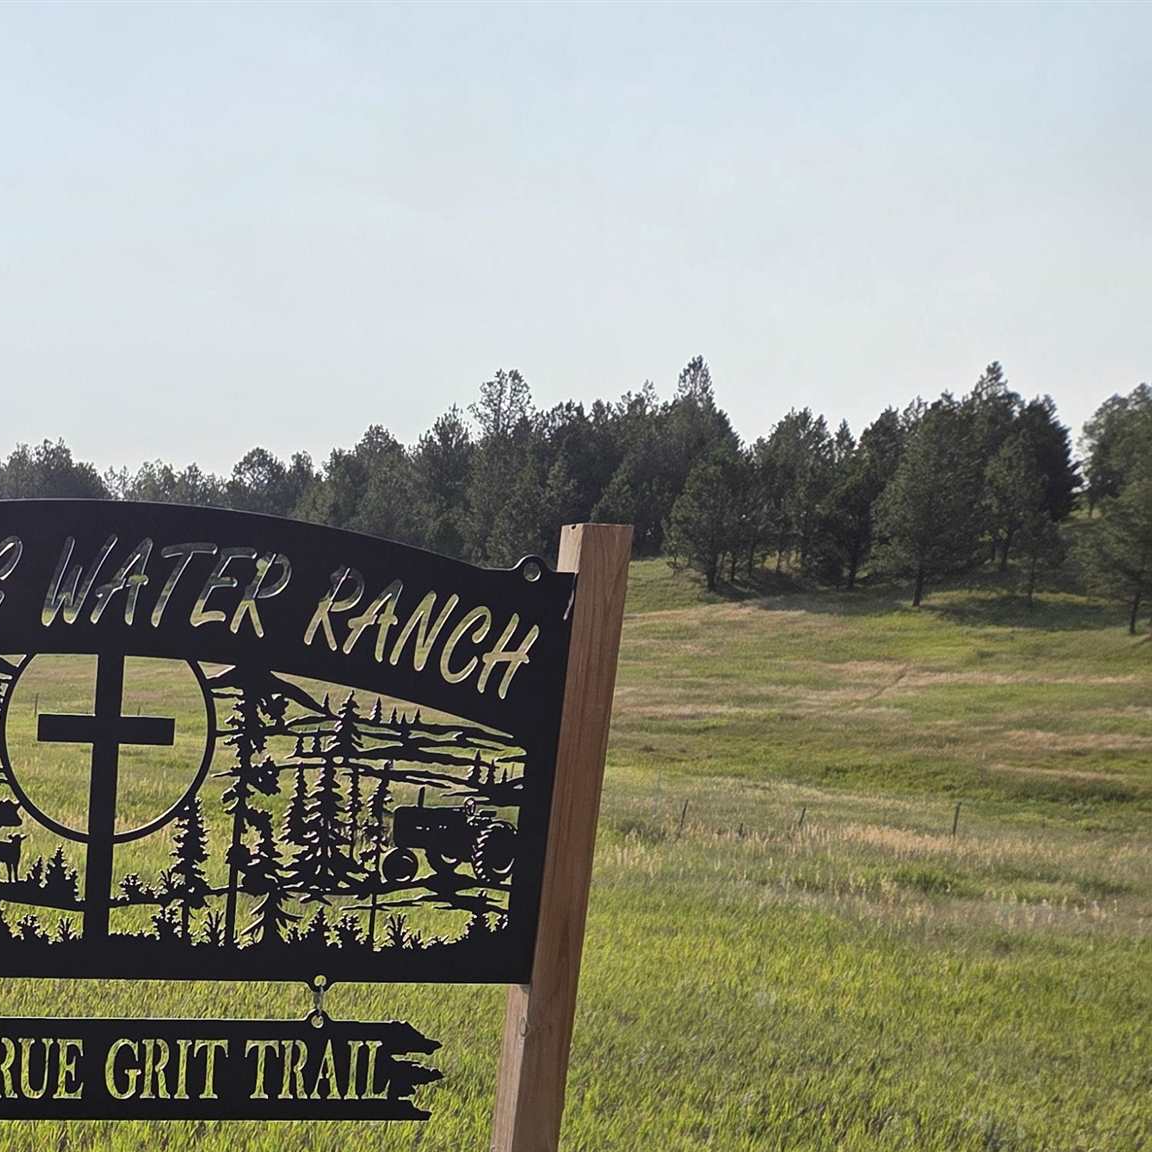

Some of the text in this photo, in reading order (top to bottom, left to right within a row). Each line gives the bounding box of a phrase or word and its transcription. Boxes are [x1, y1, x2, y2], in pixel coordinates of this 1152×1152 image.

[41, 535, 294, 637] WATER
[304, 566, 540, 699] RANCH
[105, 1038, 230, 1099] GRIT
[245, 1039, 391, 1100] TRAIL
